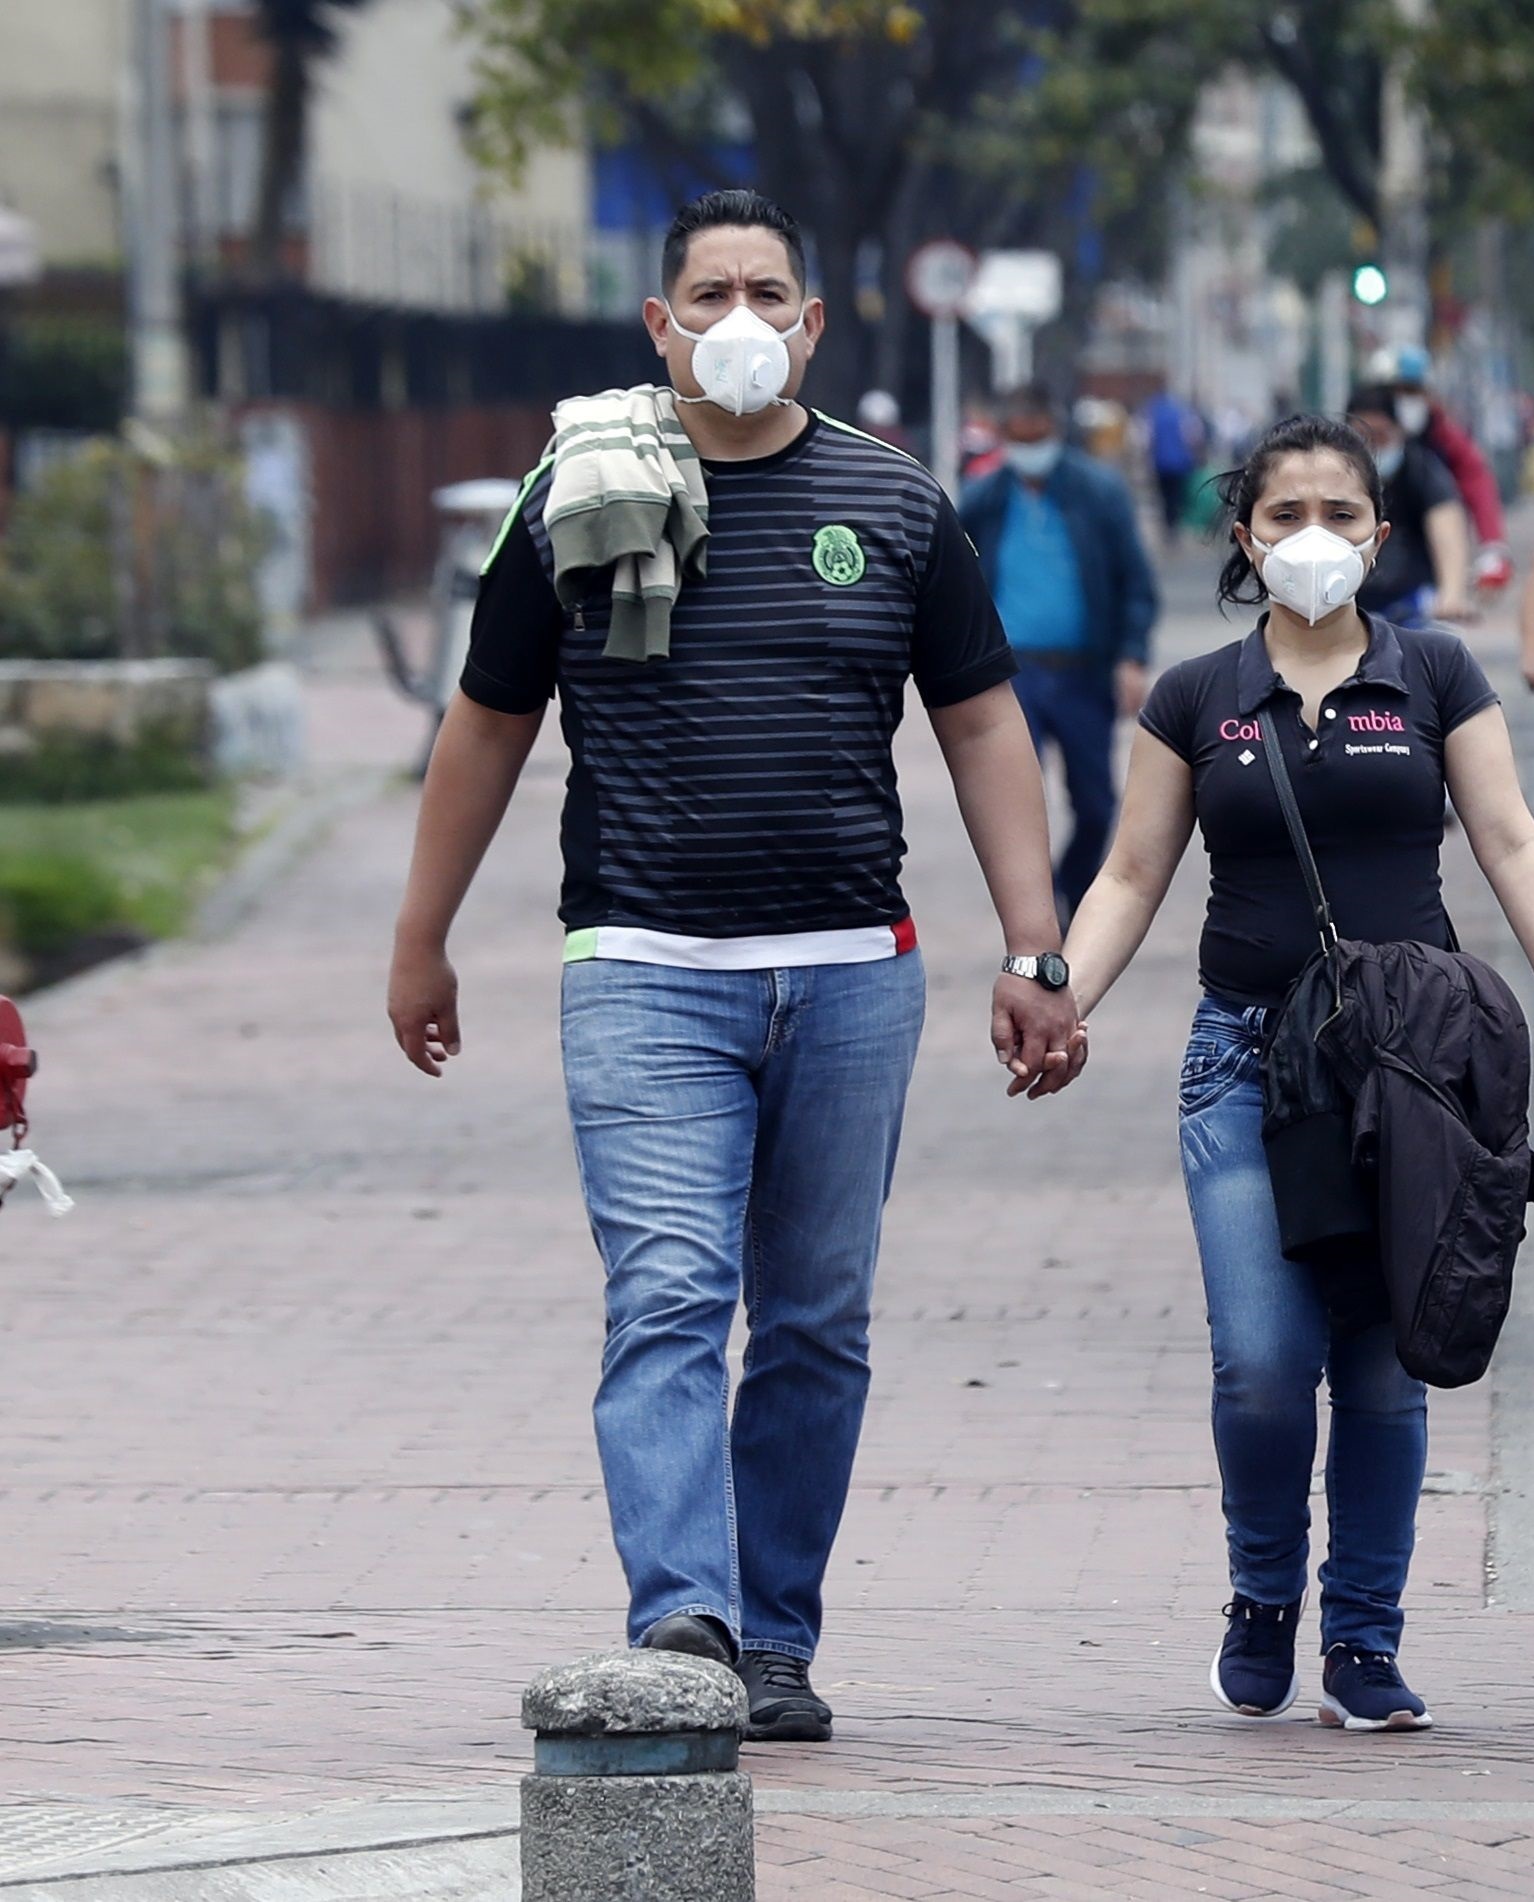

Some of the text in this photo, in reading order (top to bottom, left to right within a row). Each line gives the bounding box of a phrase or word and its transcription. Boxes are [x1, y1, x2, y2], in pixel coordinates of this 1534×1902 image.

[1348, 710, 1405, 732] mbia
[1345, 742, 1411, 757] Sportswear Company
